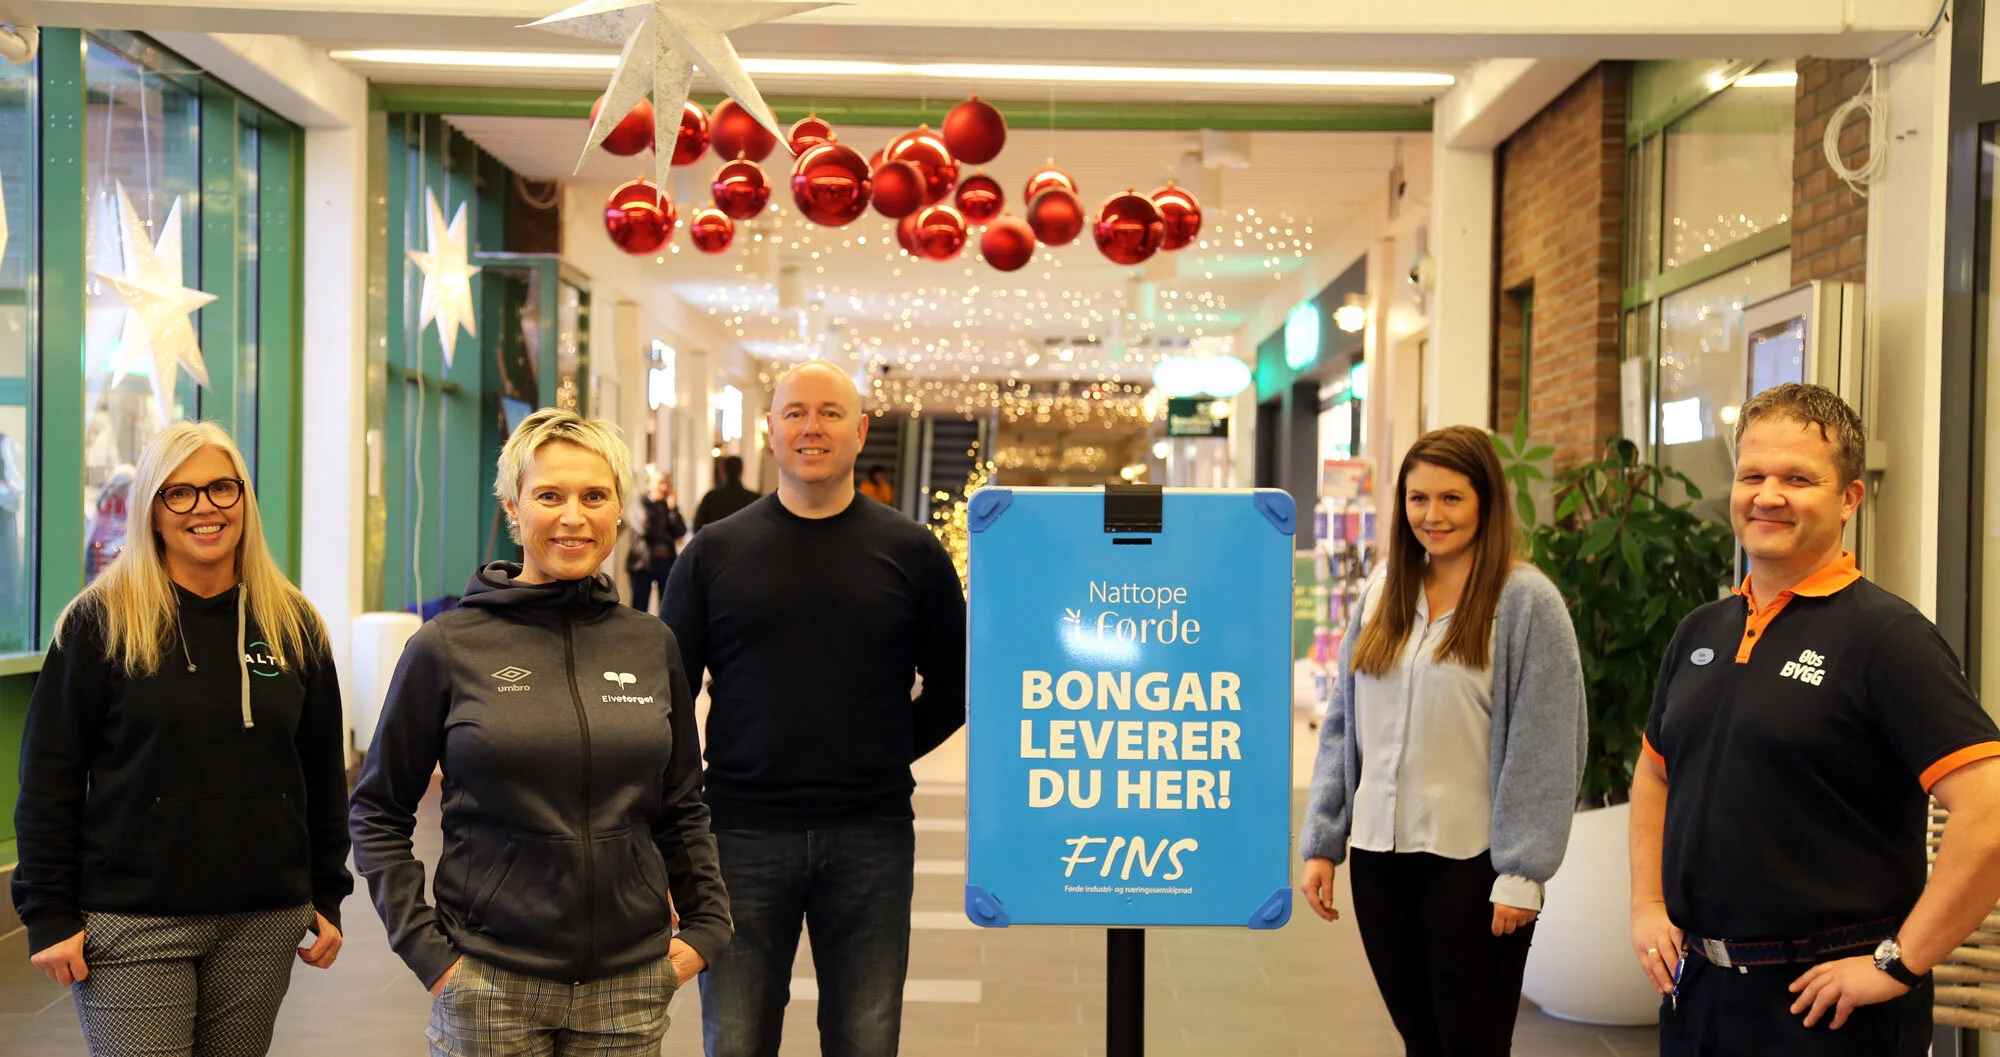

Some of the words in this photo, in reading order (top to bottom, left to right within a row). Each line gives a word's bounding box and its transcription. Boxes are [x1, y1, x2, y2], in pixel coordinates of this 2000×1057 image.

[1089, 580, 1188, 610] Nattope
[1779, 660, 1826, 686] BYGG
[497, 684, 531, 693] umbro
[601, 695, 654, 704] Elvetorget
[1022, 670, 1242, 711] BONGAR
[1020, 719, 1242, 760] LEVERER
[1028, 769, 1102, 809] DU
[1117, 770, 1231, 810] HER!
[1060, 835, 1199, 881] FINS
[1114, 886, 1124, 895] og
[1125, 886, 1193, 895] næringssamskipnad
